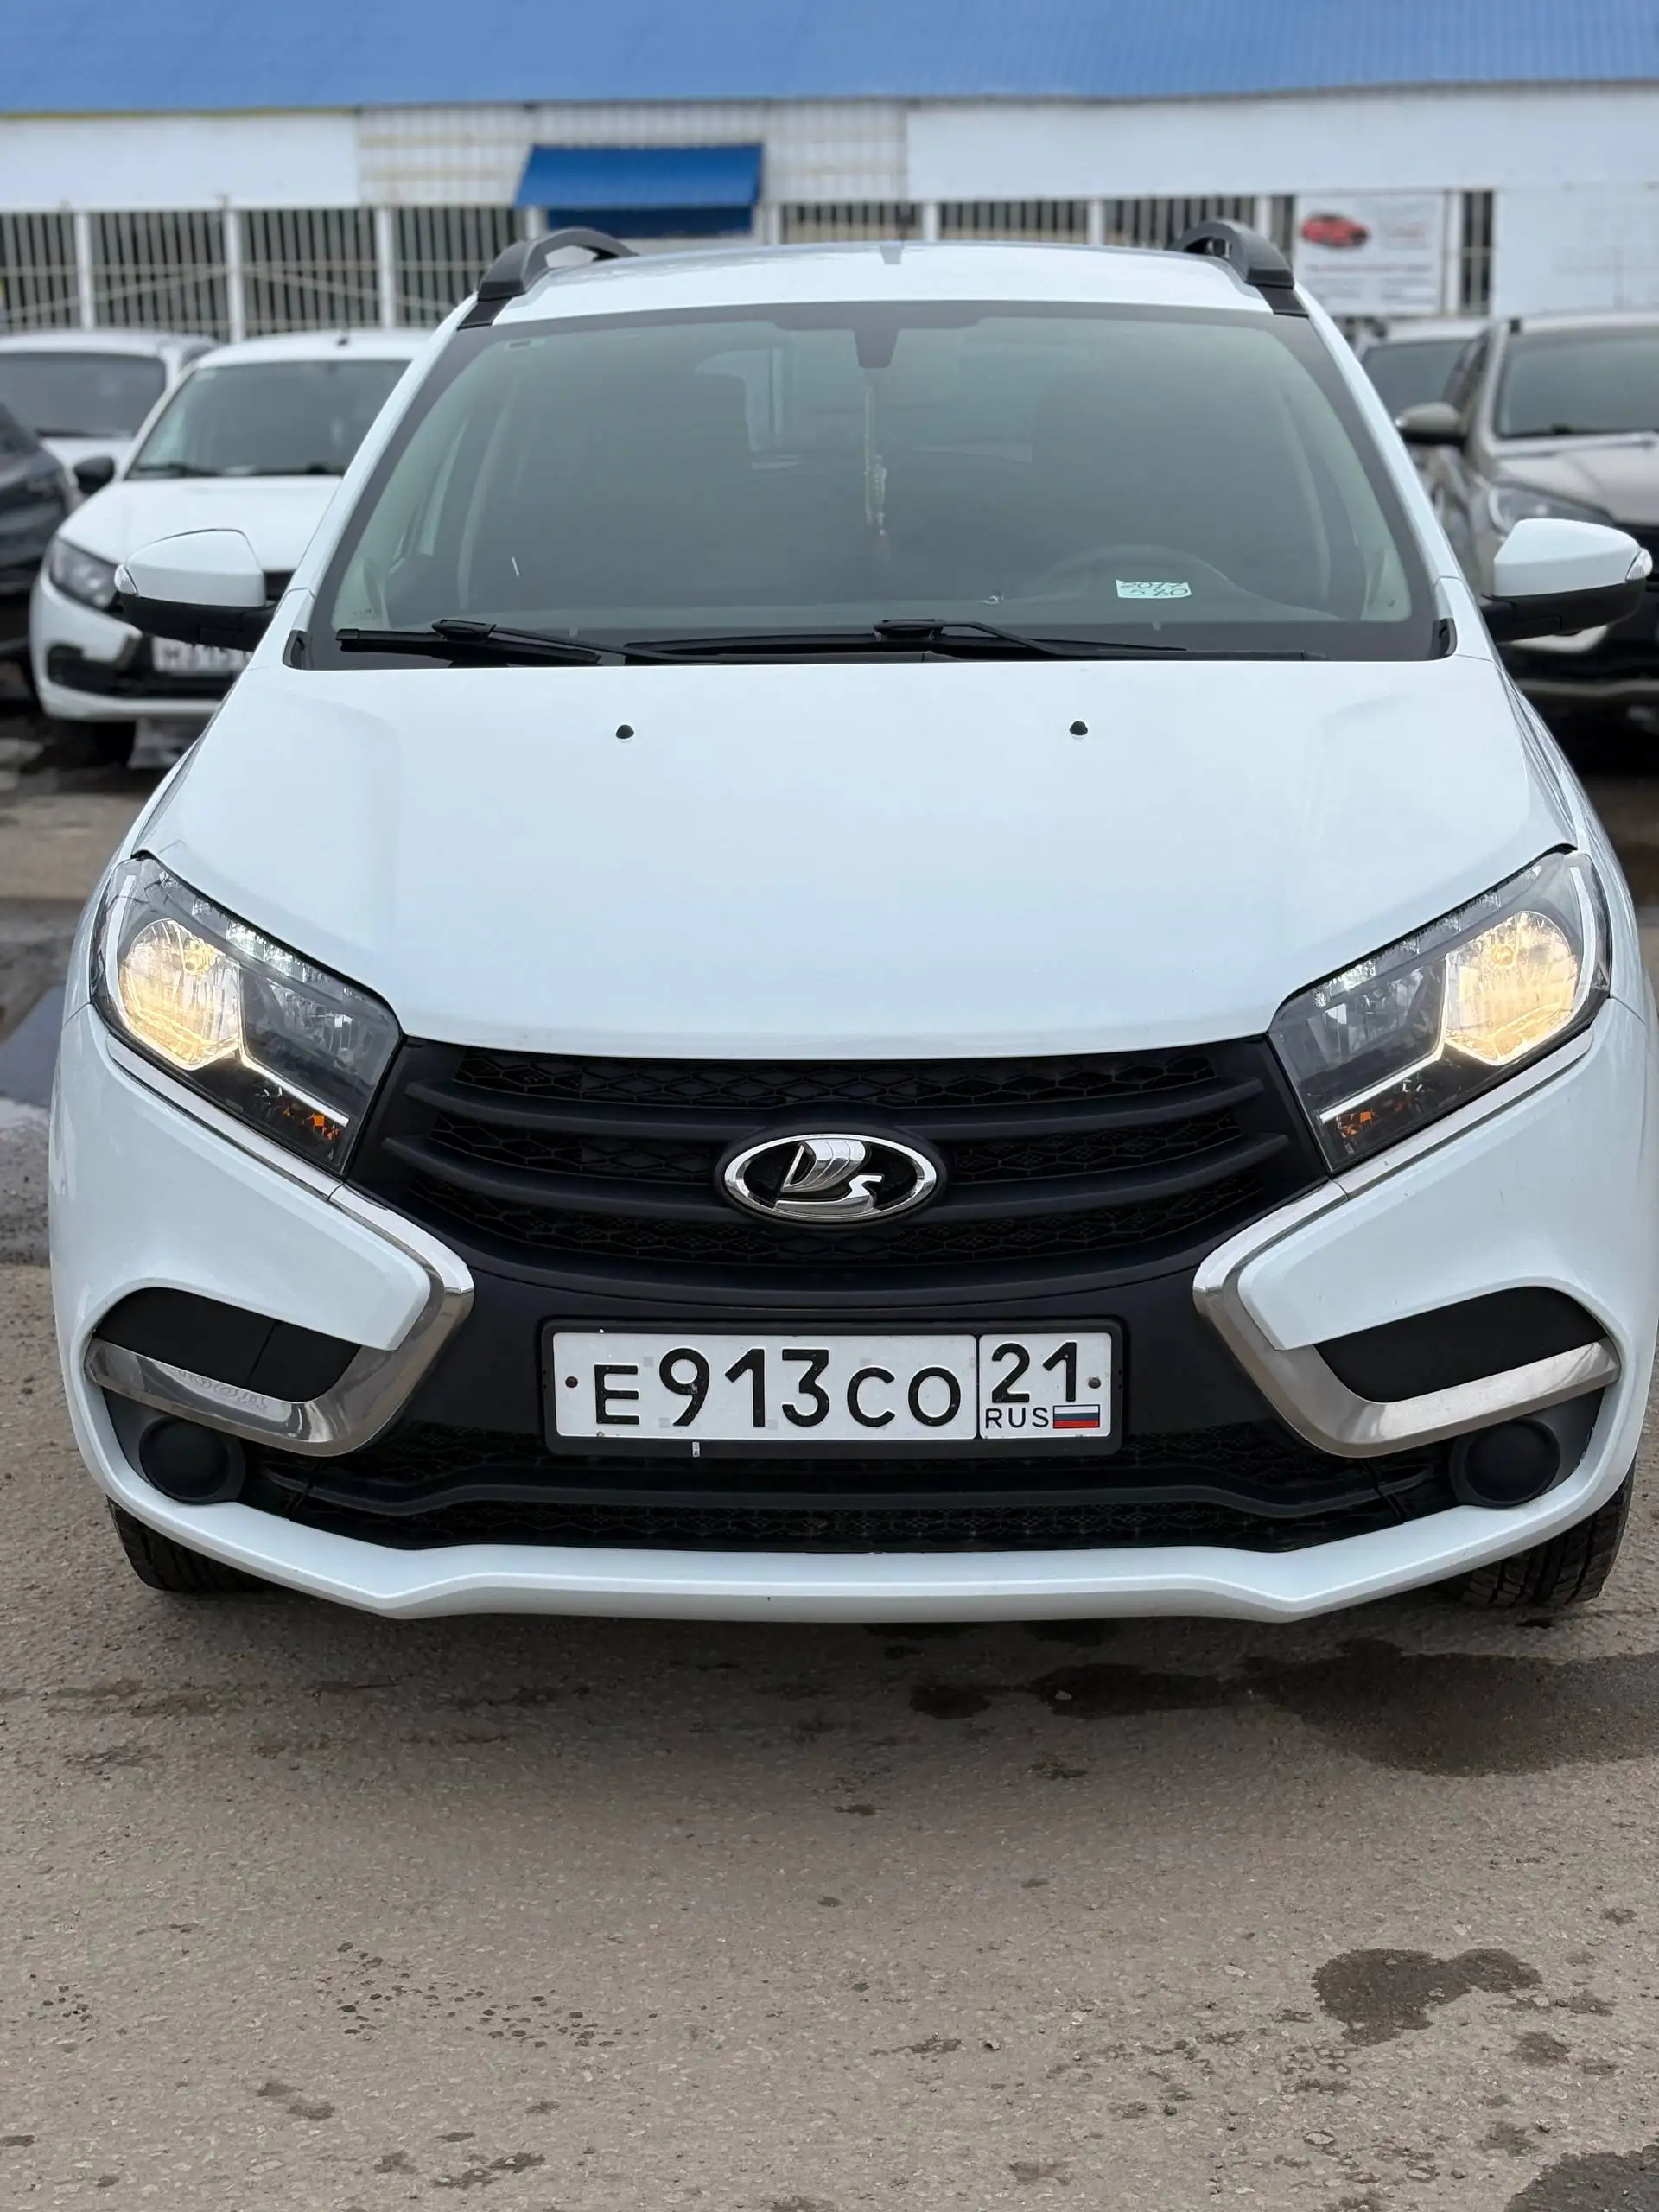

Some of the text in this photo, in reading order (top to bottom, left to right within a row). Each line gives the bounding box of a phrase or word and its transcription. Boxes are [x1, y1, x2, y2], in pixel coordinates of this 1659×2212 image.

[594, 1341, 1077, 1427] Е913СО 21
[985, 1406, 1049, 1429] RUS
